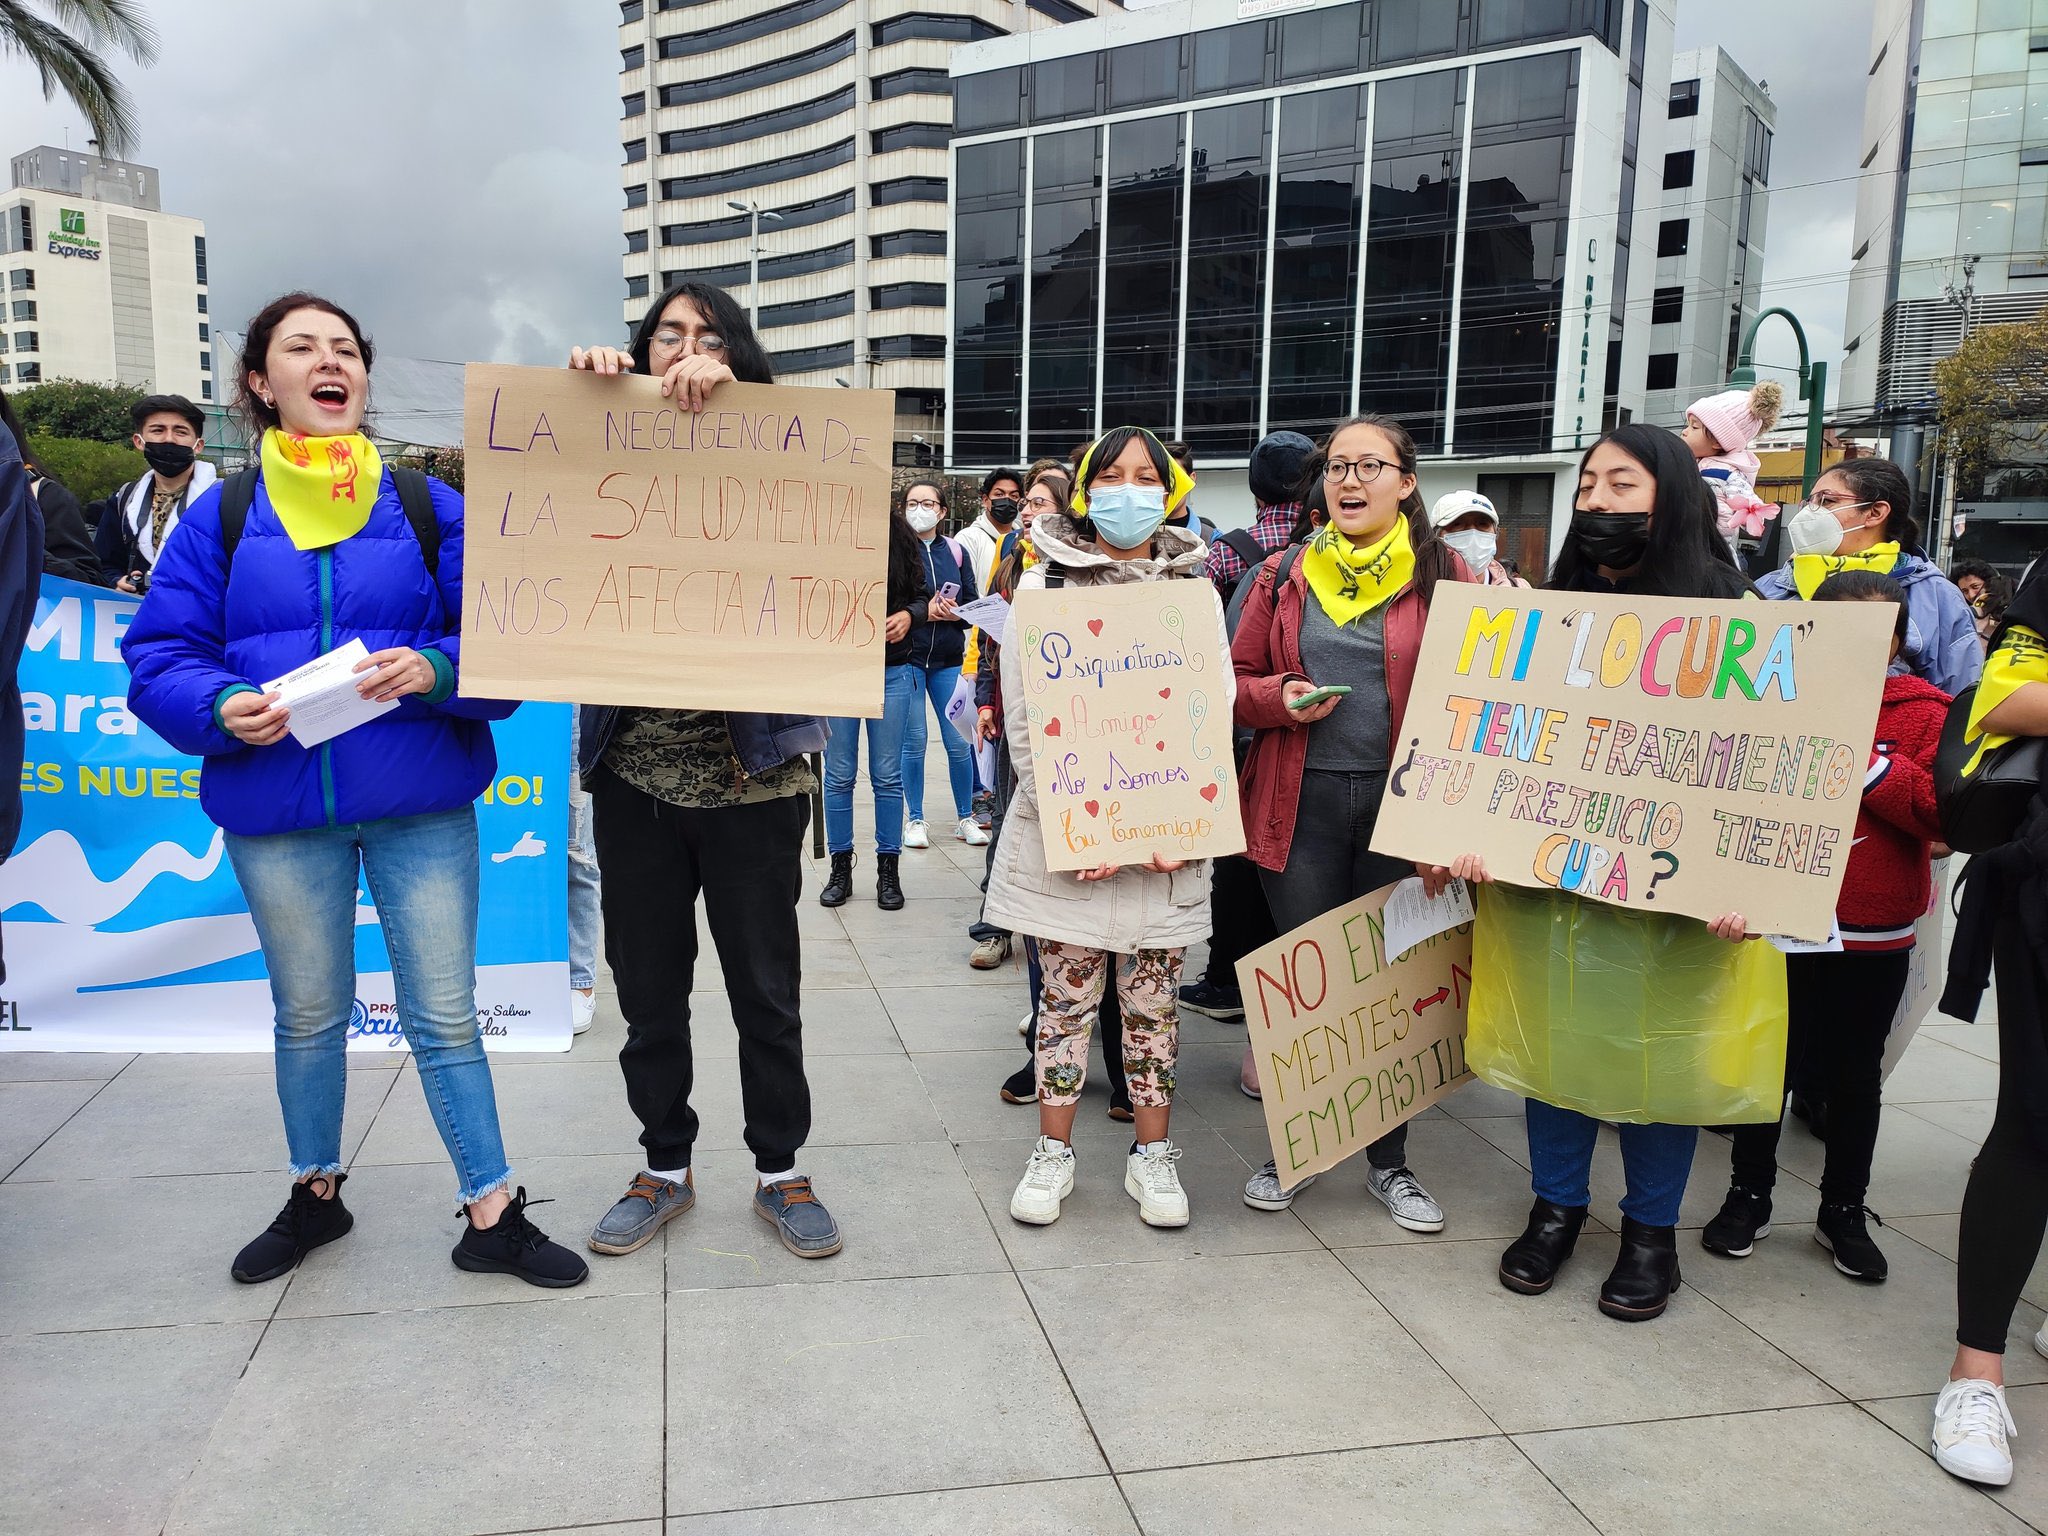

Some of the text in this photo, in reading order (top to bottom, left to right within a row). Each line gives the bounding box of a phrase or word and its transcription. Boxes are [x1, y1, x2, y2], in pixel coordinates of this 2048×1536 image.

[48, 231, 85, 247] Holiday
[48, 241, 100, 260] Express
[1577, 274, 1594, 402] NOTARIA
[488, 386, 871, 465] LA NEGLIGENCIA DE
[500, 471, 876, 551] LA SALUD MENTAL
[476, 576, 569, 635] NOS
[584, 563, 747, 636] AFECTA
[756, 574, 778, 637] A
[1041, 632, 1182, 688] Psiquiatras
[1453, 605, 1544, 682] MI
[1066, 694, 1163, 745] Amigo
[1446, 694, 1855, 800] TIENE TRATAMIENTO
[79, 765, 201, 799] NUES
[1051, 751, 1190, 795] No Somos
[1392, 737, 1841, 877] ¿TU PREJUICIO TIENE
[1105, 801, 1214, 852] Enemigo
[1533, 833, 1680, 902] CURA?
[493, 1004, 532, 1017] Salvar
[1255, 938, 1327, 1030] NO
[1271, 987, 1410, 1102] MENTES
